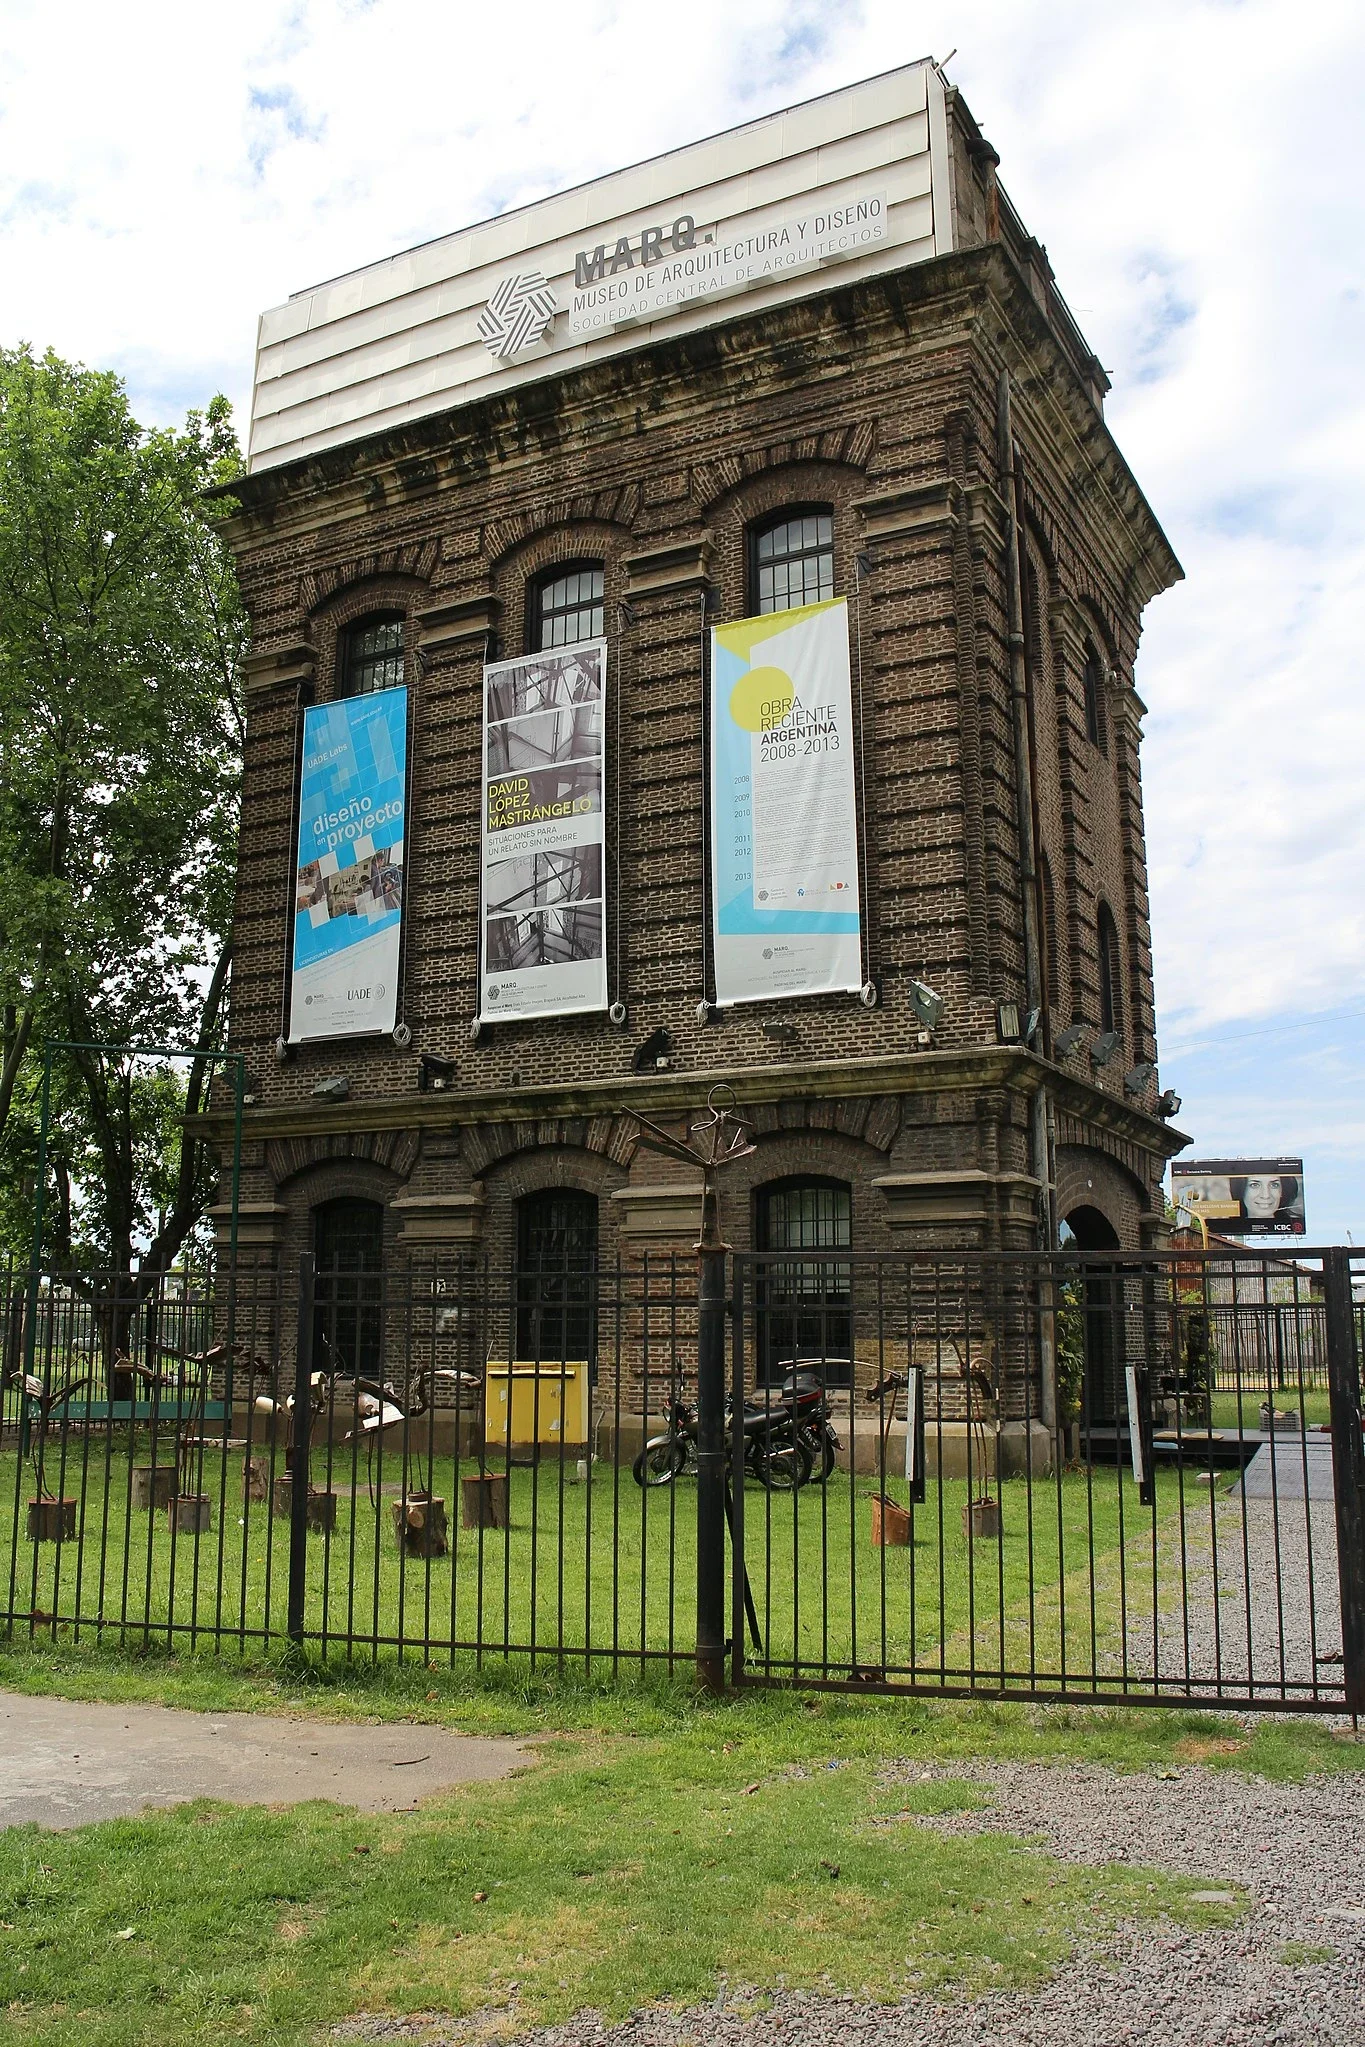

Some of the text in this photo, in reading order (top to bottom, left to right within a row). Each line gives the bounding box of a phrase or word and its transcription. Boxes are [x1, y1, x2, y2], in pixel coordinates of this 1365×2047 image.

[573, 199, 881, 313] MUSEO DE ARQUITECTURA Y DISEÑO
[575, 215, 713, 289] MARQ.
[572, 225, 883, 333] SOCIEDAD CENTRAL DE ARQUITECTOS
[760, 695, 803, 717] OBRA
[761, 704, 837, 733] RECIENTE
[760, 721, 838, 746] ARGENTINA
[307, 743, 349, 769] UADE Labs
[760, 735, 841, 763] 2008-2013
[489, 778, 529, 799] DAVID
[734, 775, 750, 785] 2008
[489, 793, 530, 814] LÓPEZ
[734, 793, 750, 803] 2009
[313, 796, 372, 836] diseño
[489, 798, 592, 830] MASTRÁNGELO
[734, 809, 751, 818] 2010
[316, 800, 403, 852] en proyecto
[488, 826, 558, 847] SITUACIONES PARA
[488, 832, 579, 856] UN RELATO SIN NOMBRE
[734, 835, 751, 844] 2011
[734, 847, 752, 857] 2012
[734, 872, 752, 881] 2013
[347, 988, 372, 1001] UADE
